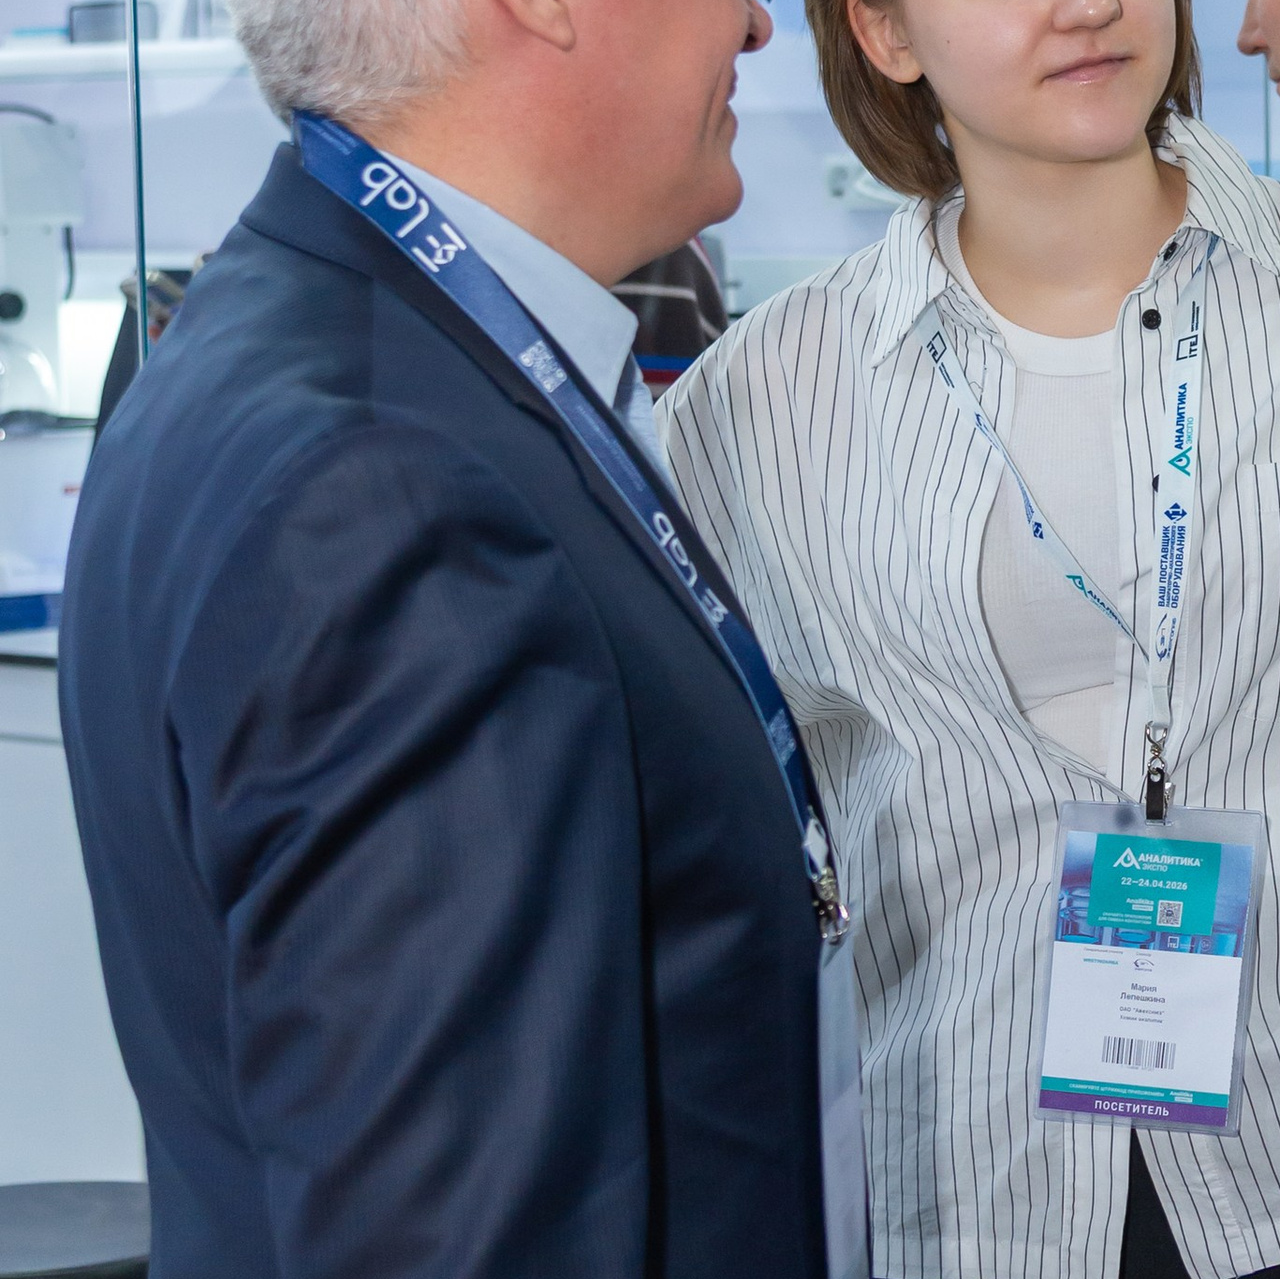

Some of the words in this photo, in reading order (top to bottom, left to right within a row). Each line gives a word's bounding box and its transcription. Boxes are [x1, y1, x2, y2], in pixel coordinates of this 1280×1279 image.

[1174, 382, 1188, 450] АНАЛИТИКА
[1186, 416, 1194, 445] ЭКСПО
[1159, 525, 1171, 584] ПОСТАВЩИК
[1171, 525, 1186, 609] ОБОРУДОВАНИЯ
[1158, 586, 1167, 607] ВАШ
[1138, 853, 1201, 867] АНАЛИТИКА
[1142, 863, 1168, 872] ЭКСПО
[1130, 983, 1157, 993] Мария
[1120, 992, 1166, 1004] Лепешкина
[1094, 1100, 1170, 1117] ПОСЕТИТЕЛЬ
